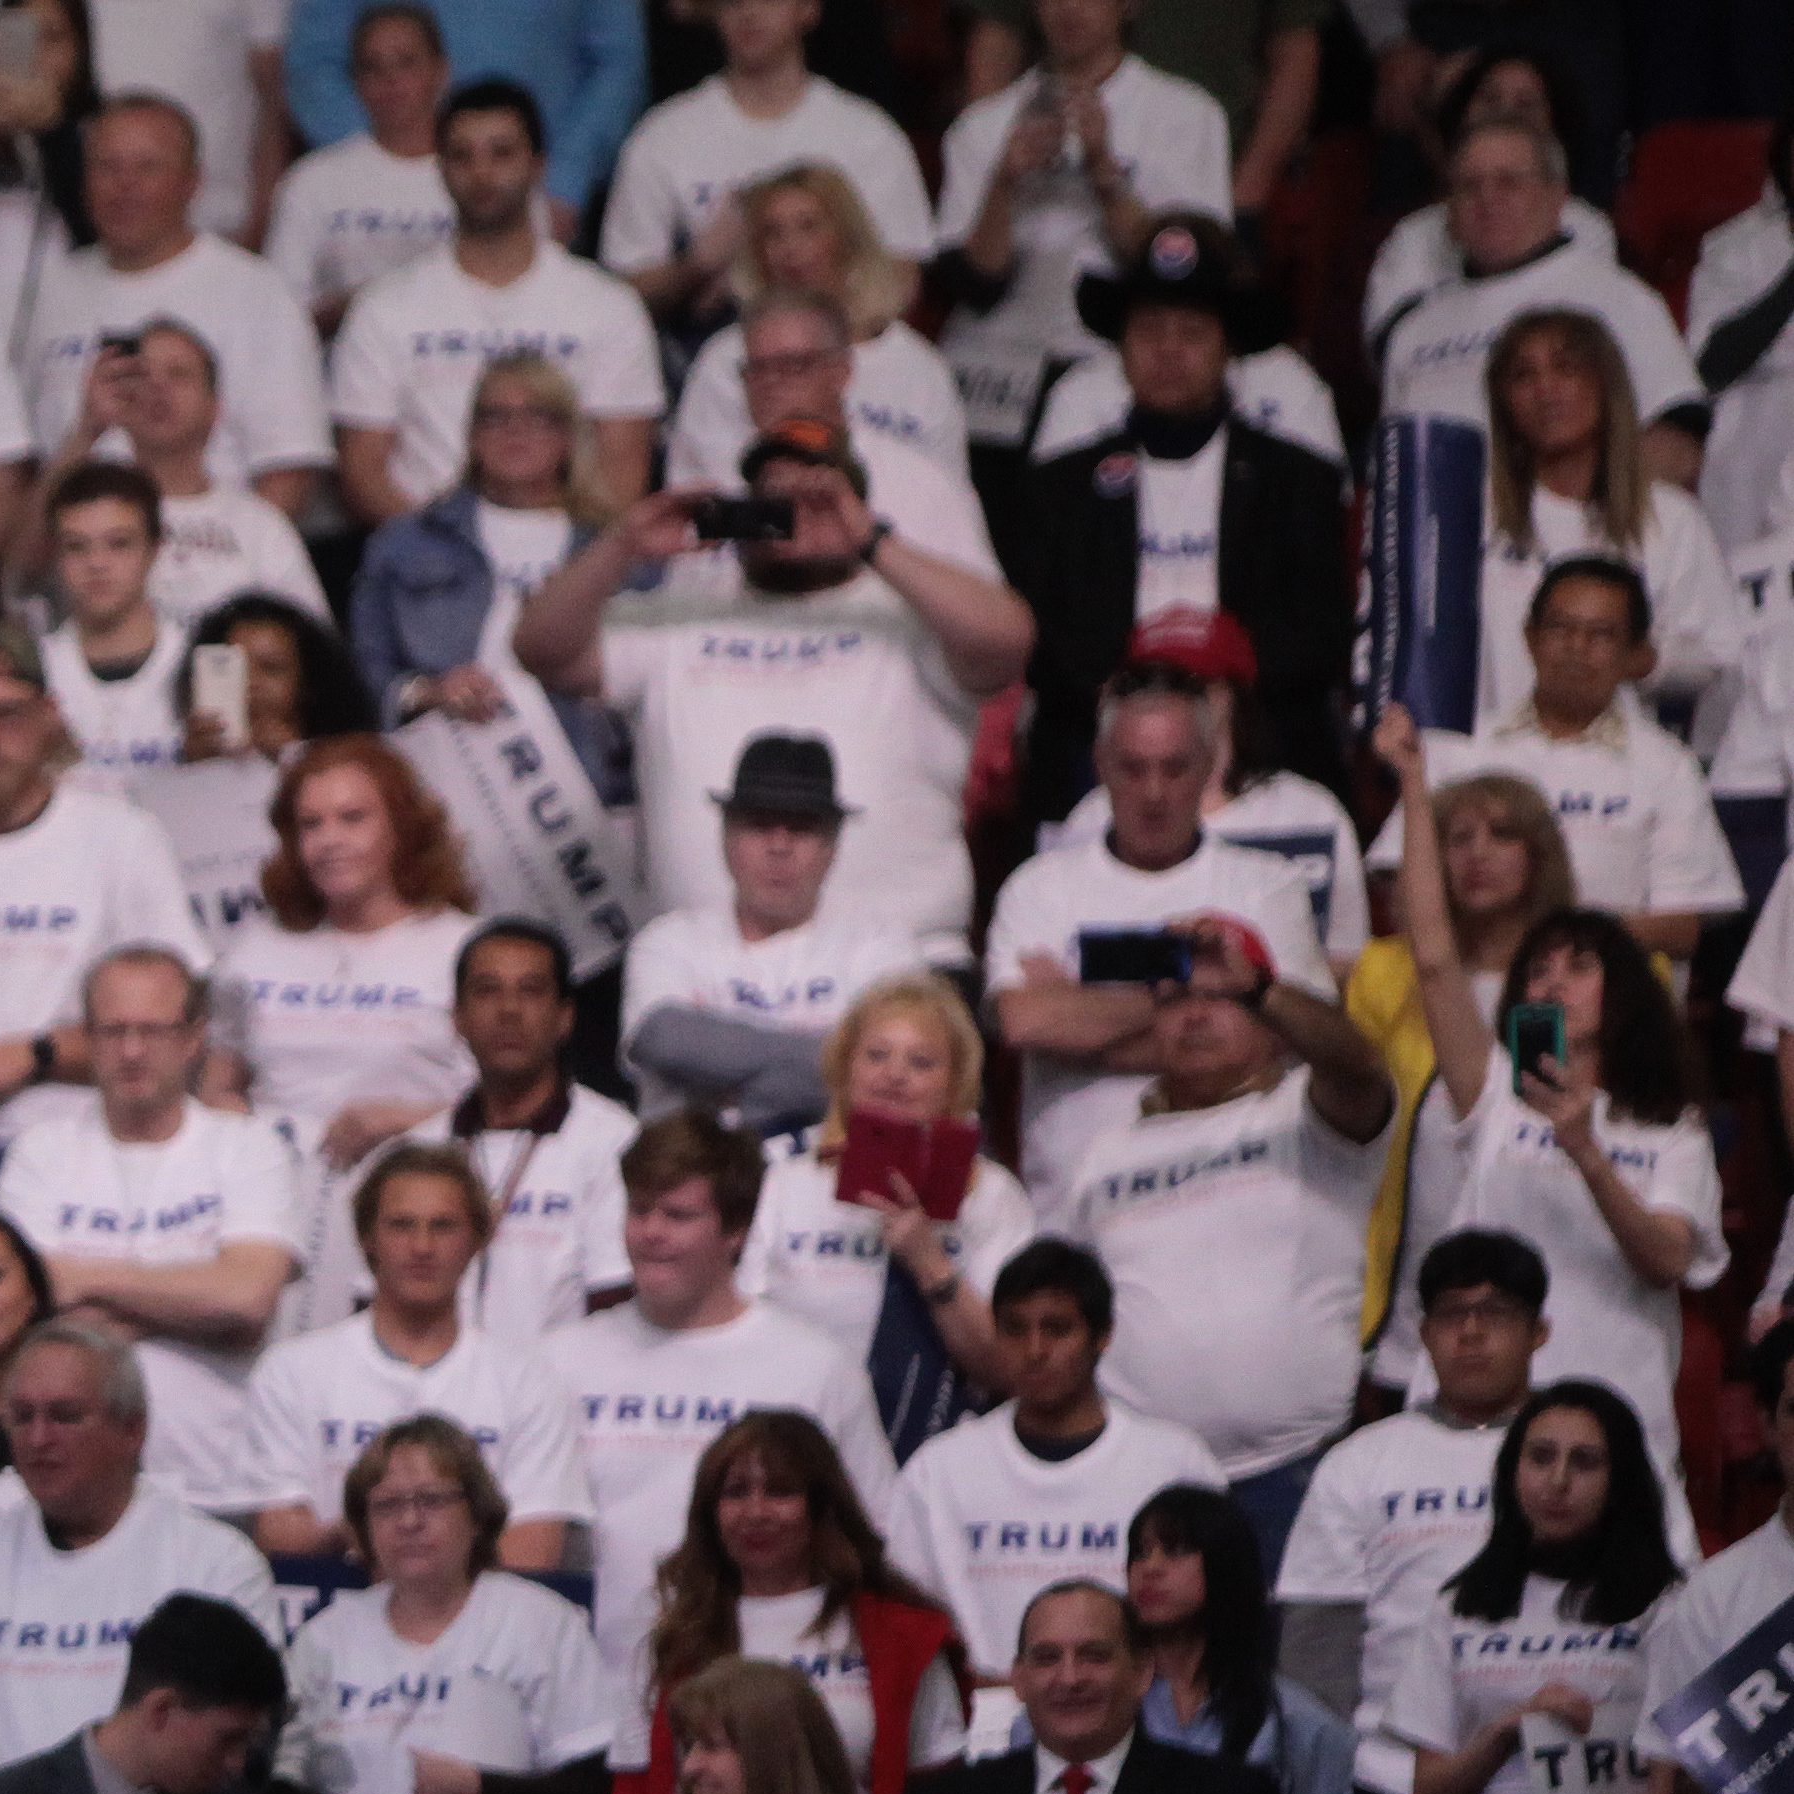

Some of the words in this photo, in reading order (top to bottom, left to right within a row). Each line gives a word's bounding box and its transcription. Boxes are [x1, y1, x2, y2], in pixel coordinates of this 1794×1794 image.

[502, 735, 632, 945] RUMP
[580, 1394, 737, 1425] TRUM
[1375, 1490, 1492, 1525] TRU
[966, 1521, 1118, 1552] TRUM
[1452, 1629, 1641, 1659] TRUMP
